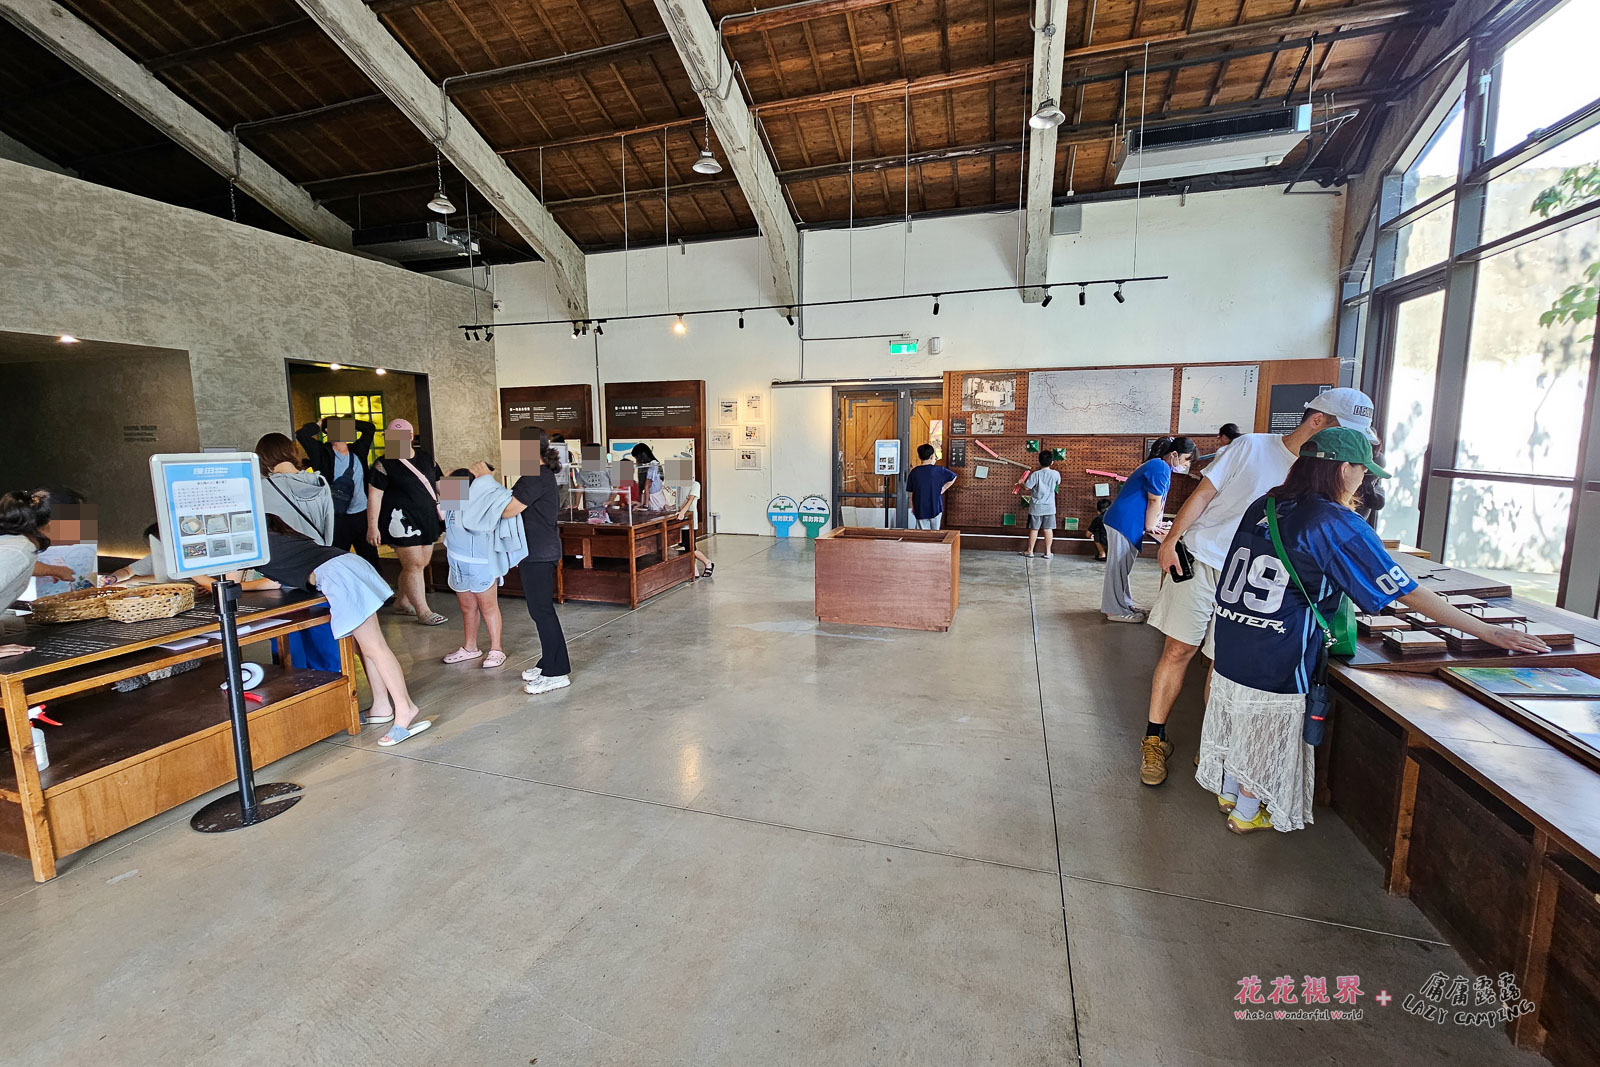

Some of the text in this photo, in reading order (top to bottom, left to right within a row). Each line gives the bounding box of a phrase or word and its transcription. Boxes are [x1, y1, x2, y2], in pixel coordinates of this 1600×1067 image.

[1220, 547, 1290, 614] 09
[1375, 565, 1411, 596] 09
[1216, 604, 1283, 630] UNTER
